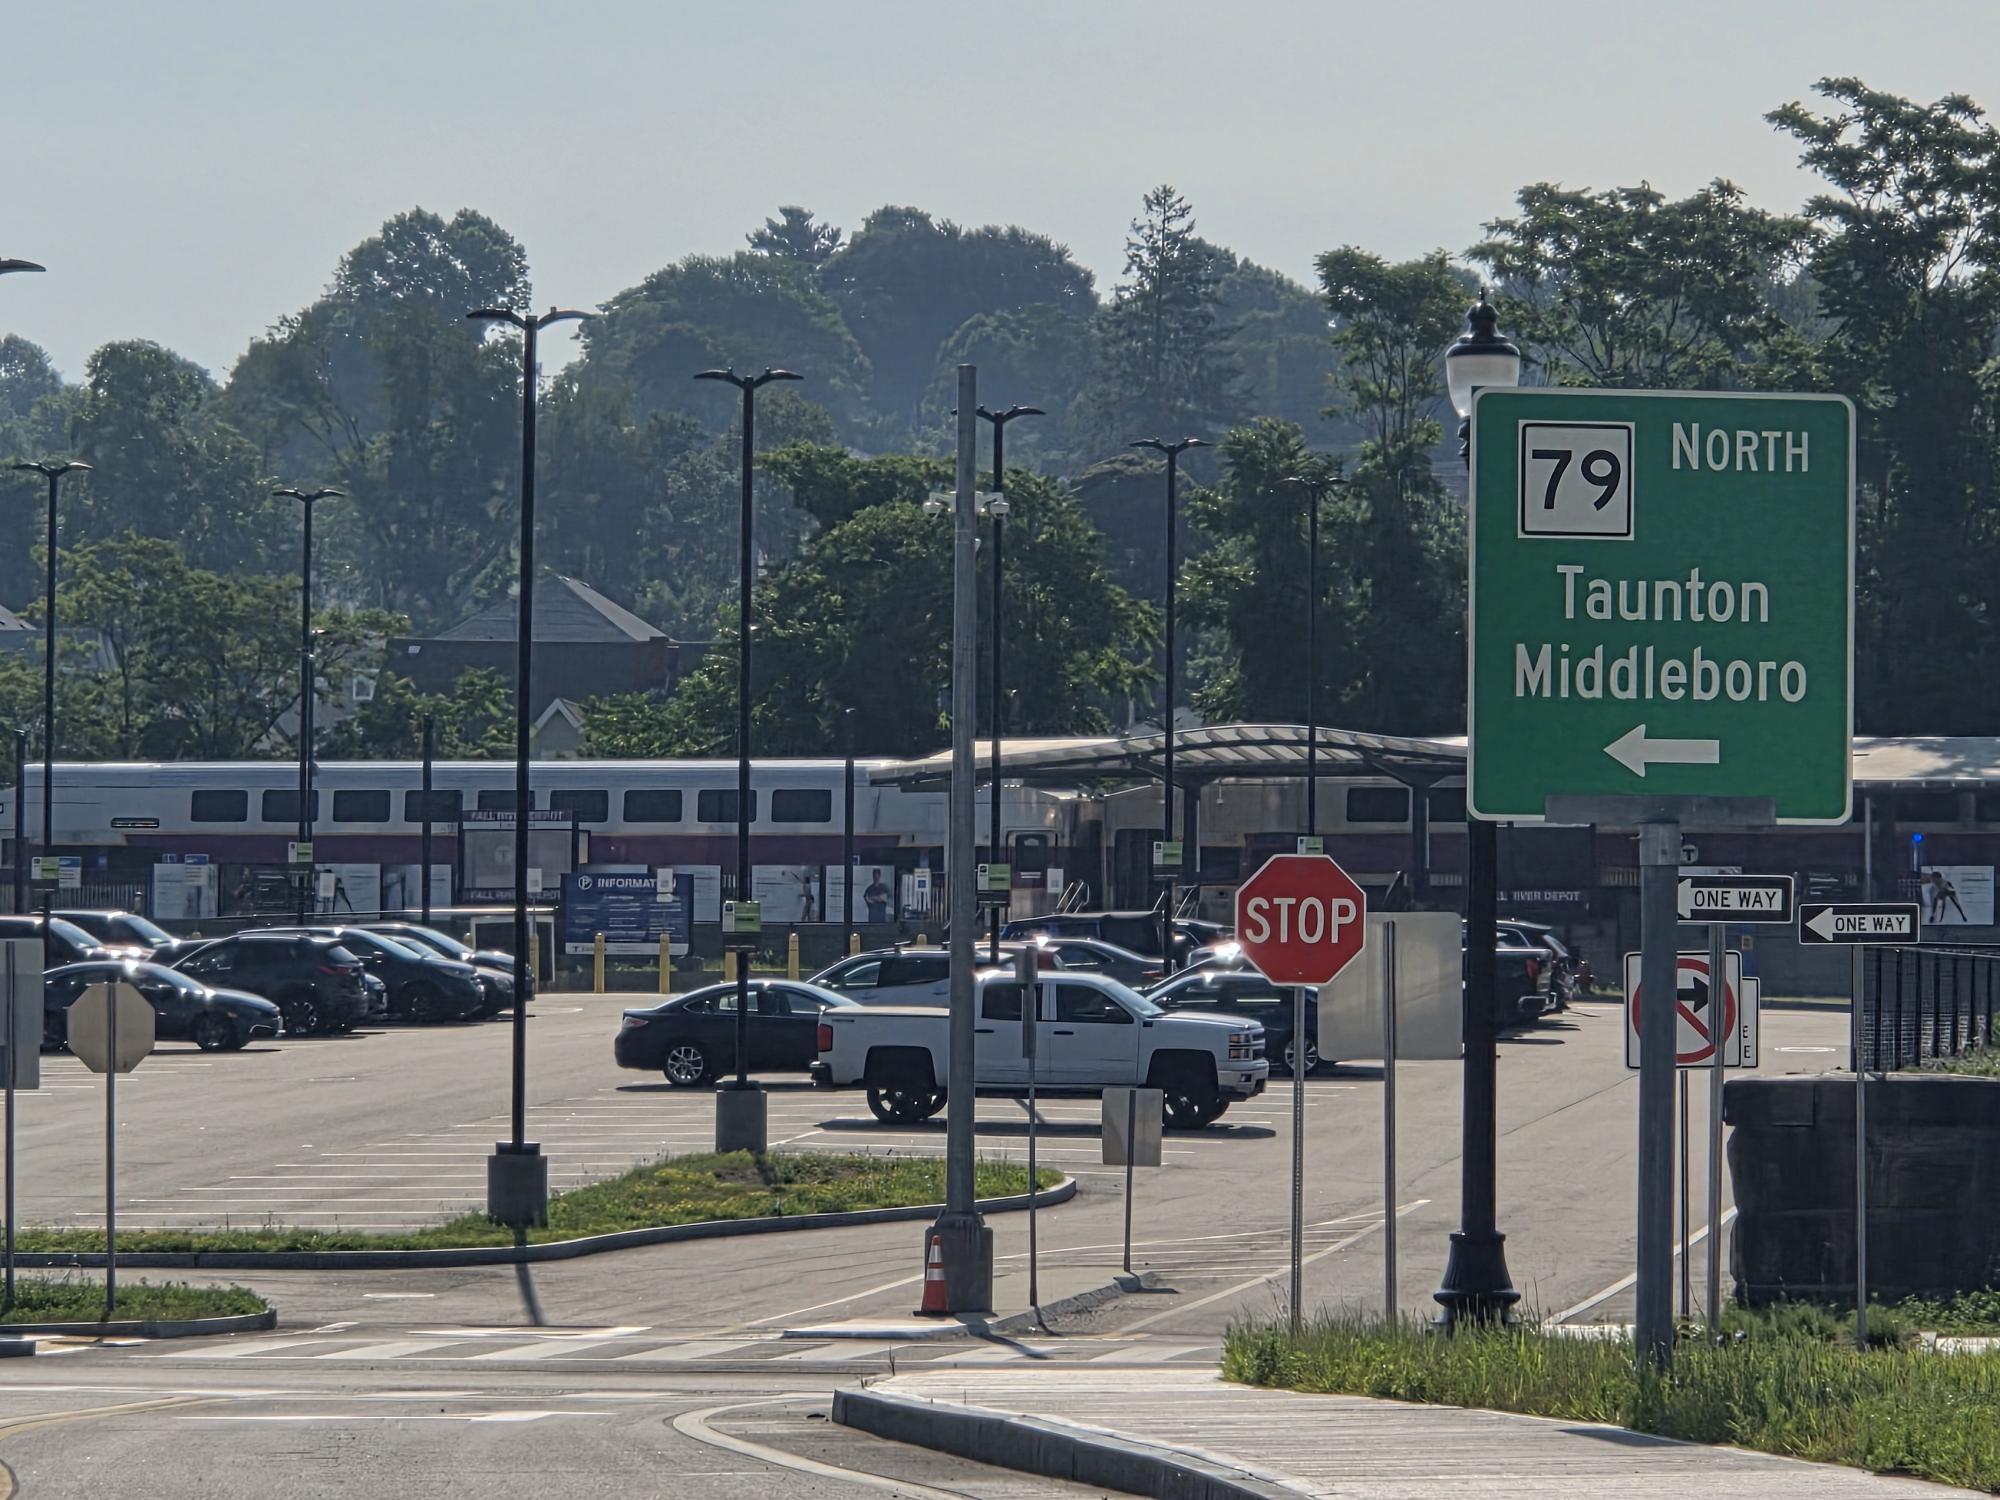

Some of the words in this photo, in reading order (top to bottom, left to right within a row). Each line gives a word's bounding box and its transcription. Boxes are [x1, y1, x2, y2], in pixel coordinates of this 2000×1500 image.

[1672, 422, 1808, 472] NORTH
[1531, 448, 1622, 512] 79
[1556, 564, 1769, 622] Taunton
[1514, 643, 1807, 703] Middleboro
[1245, 896, 1357, 944] STOP
[1694, 890, 1731, 908] ONE
[1738, 891, 1777, 908] WAY
[1835, 916, 1867, 932] ONE
[1873, 916, 1905, 932] WAY
